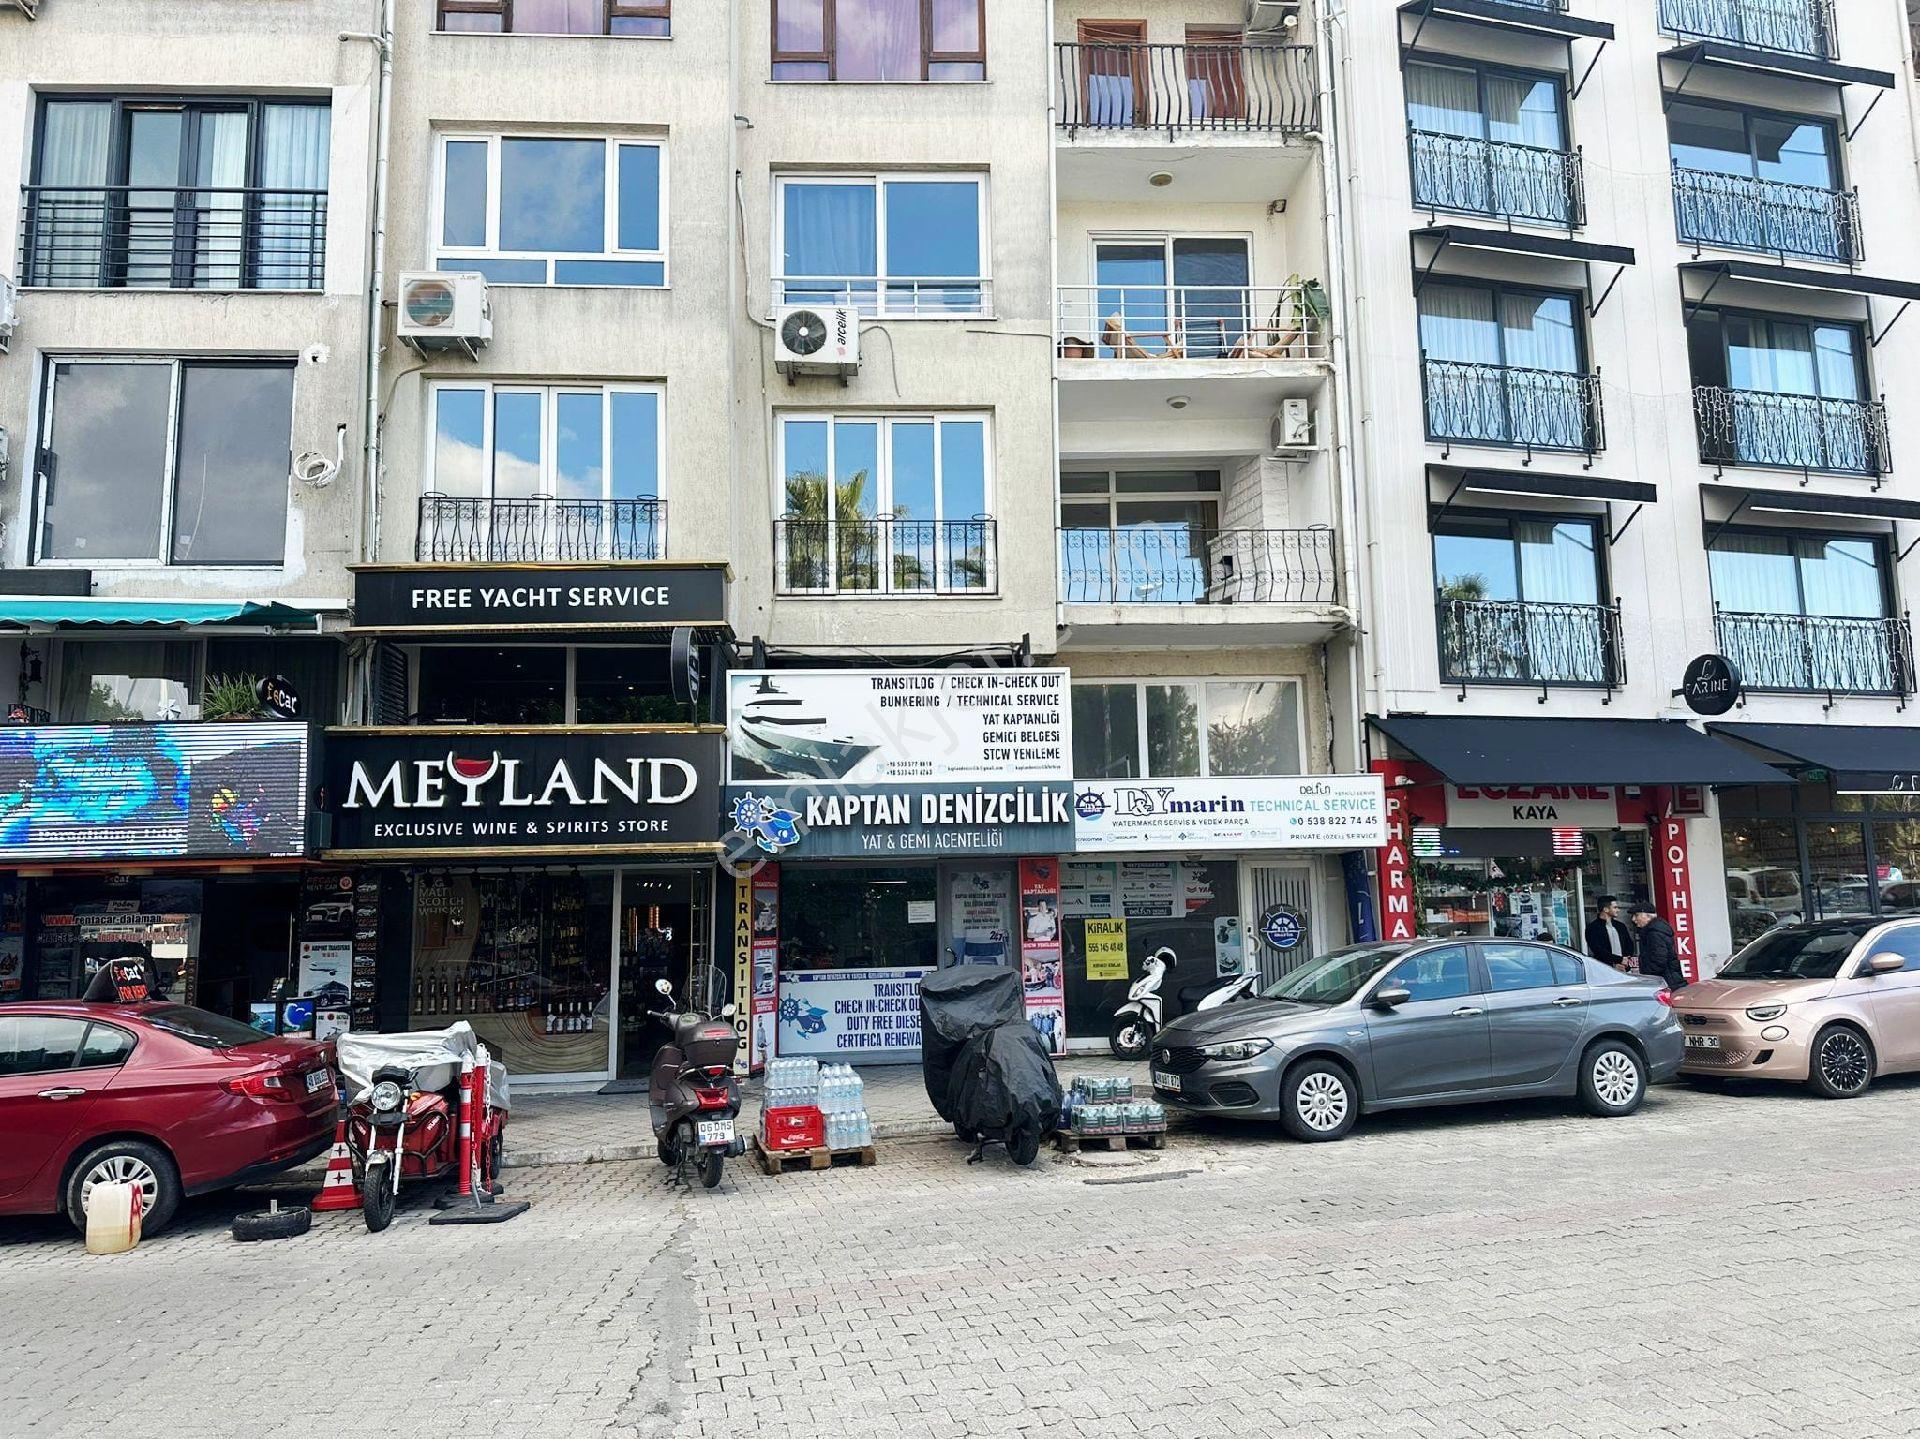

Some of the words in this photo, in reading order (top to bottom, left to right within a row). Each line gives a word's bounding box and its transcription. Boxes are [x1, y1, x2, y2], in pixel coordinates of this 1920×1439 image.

[412, 588, 472, 608] FREE
[480, 587, 561, 607] YACHT
[568, 586, 669, 607] SERVICE
[871, 677, 935, 690] TRANSITLOG
[951, 676, 984, 689] CHECK
[1041, 675, 1060, 688] OUT
[880, 695, 940, 707] BUNKERING
[957, 694, 1013, 706] TECHNICAL
[1017, 694, 1060, 706] SERVICE
[982, 714, 1000, 725] YAT
[983, 749, 1010, 760] STCW
[341, 749, 699, 809] MEYLAND
[806, 794, 911, 827] KAPTAN
[921, 786, 1070, 826] DENİZCİLİK
[1249, 799, 1320, 812] TECHNICAL
[1323, 798, 1376, 811] SERVICE
[1512, 805, 1559, 820] KAYA
[374, 822, 463, 837] EXCLUSIVE
[472, 821, 518, 835] WINE
[526, 821, 538, 834] &
[546, 820, 609, 834] SPIRITS
[617, 819, 669, 833] STORE
[1307, 817, 1326, 825] 538
[1328, 817, 1347, 825] 822
[1350, 816, 1362, 825] 74
[1365, 816, 1377, 824] 45
[861, 834, 882, 849] YAT
[887, 834, 897, 848] &
[737, 884, 748, 1049] TRANSITLOG
[834, 999, 863, 1014] CHECK
[846, 1015, 869, 1031] DUTY
[873, 1014, 893, 1030] FREE
[836, 1032, 882, 1048] CERTIFICA
[707, 1132, 726, 1141] 779
